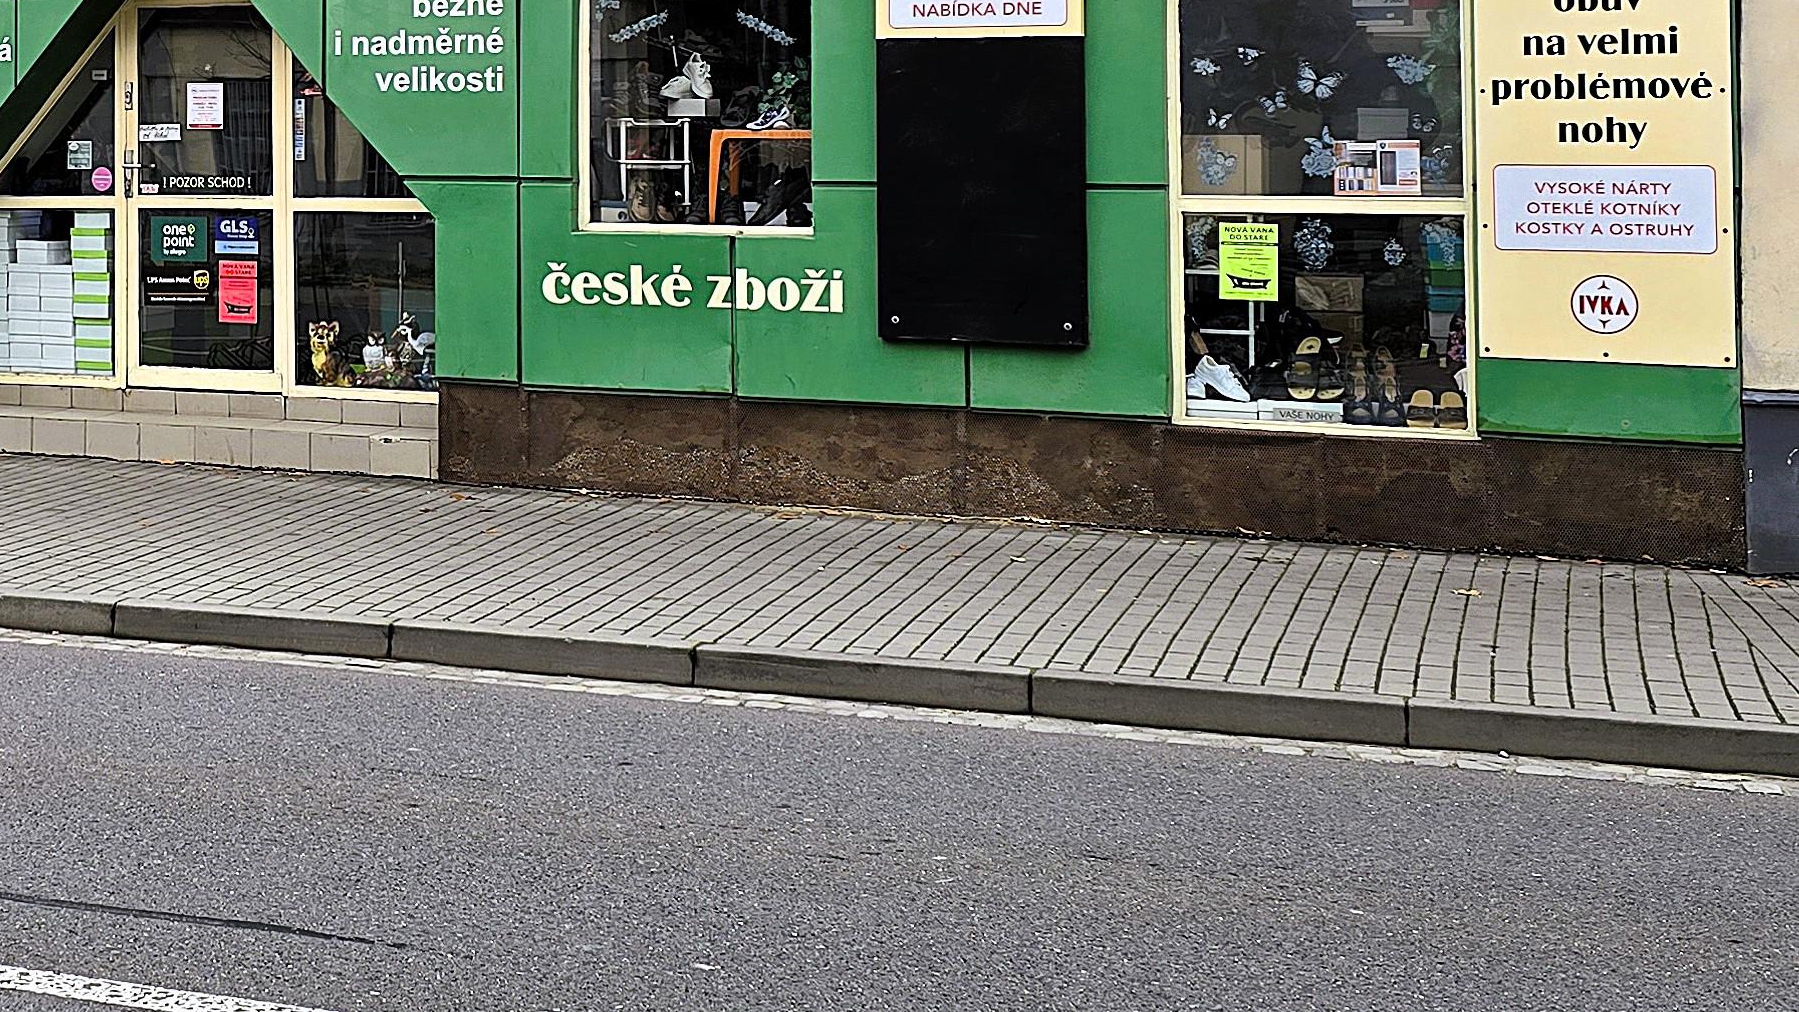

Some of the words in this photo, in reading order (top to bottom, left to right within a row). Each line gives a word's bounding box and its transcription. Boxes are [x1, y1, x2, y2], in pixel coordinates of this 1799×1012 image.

[912, 0, 997, 18] NABÍDKA
[1002, 1, 1042, 16] DNE
[334, 30, 342, 56] i
[352, 27, 504, 55] nadměrné
[1523, 35, 1566, 56] na
[1577, 26, 1678, 55] velmi
[375, 66, 504, 92] velikosti
[1491, 72, 1713, 106] problémové
[1558, 117, 1648, 149] nohy
[169, 176, 205, 188] POZOR
[207, 176, 245, 188] SCHOD
[1534, 180, 1605, 194] VYSOKÉ
[1612, 180, 1672, 195] NÁRTY
[1527, 200, 1594, 215] OTEKLÉ
[1600, 200, 1682, 216] KOTNÍKY
[162, 224, 187, 235] one
[219, 220, 249, 234] GLS
[1515, 222, 1585, 235] KOSTKY
[1591, 223, 1603, 235] A
[1609, 223, 1695, 236] OSTRUHY
[163, 235, 195, 248] point
[542, 262, 693, 307] české
[706, 268, 844, 313] zboží
[1579, 295, 1630, 316] IVKA
[1306, 412, 1334, 421] NOHY
